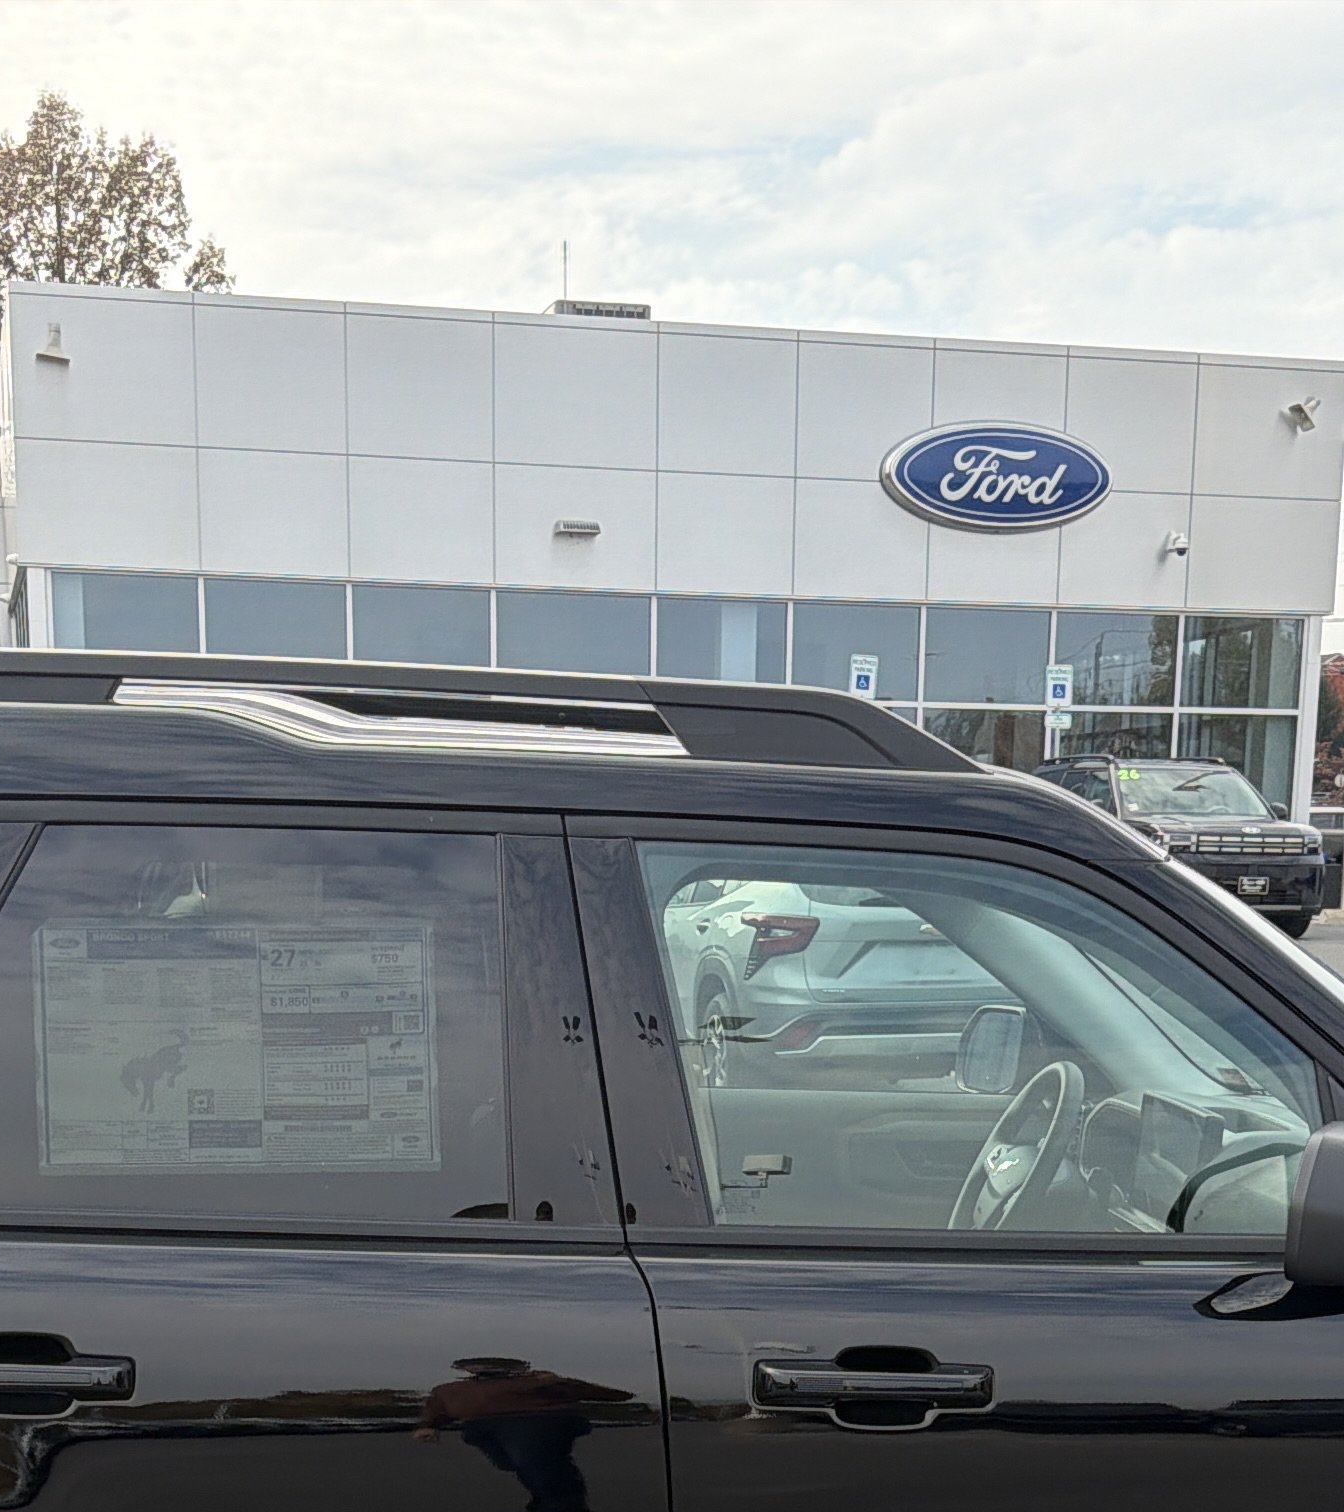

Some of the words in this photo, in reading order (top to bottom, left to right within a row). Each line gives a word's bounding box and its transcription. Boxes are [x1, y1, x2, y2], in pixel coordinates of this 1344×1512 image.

[939, 444, 1068, 505] Ford
[1117, 769, 1141, 781] 26
[91, 932, 136, 942] BRONCO
[270, 948, 296, 967] 27
[371, 953, 399, 964] $750
[270, 996, 309, 1009] $1,850
